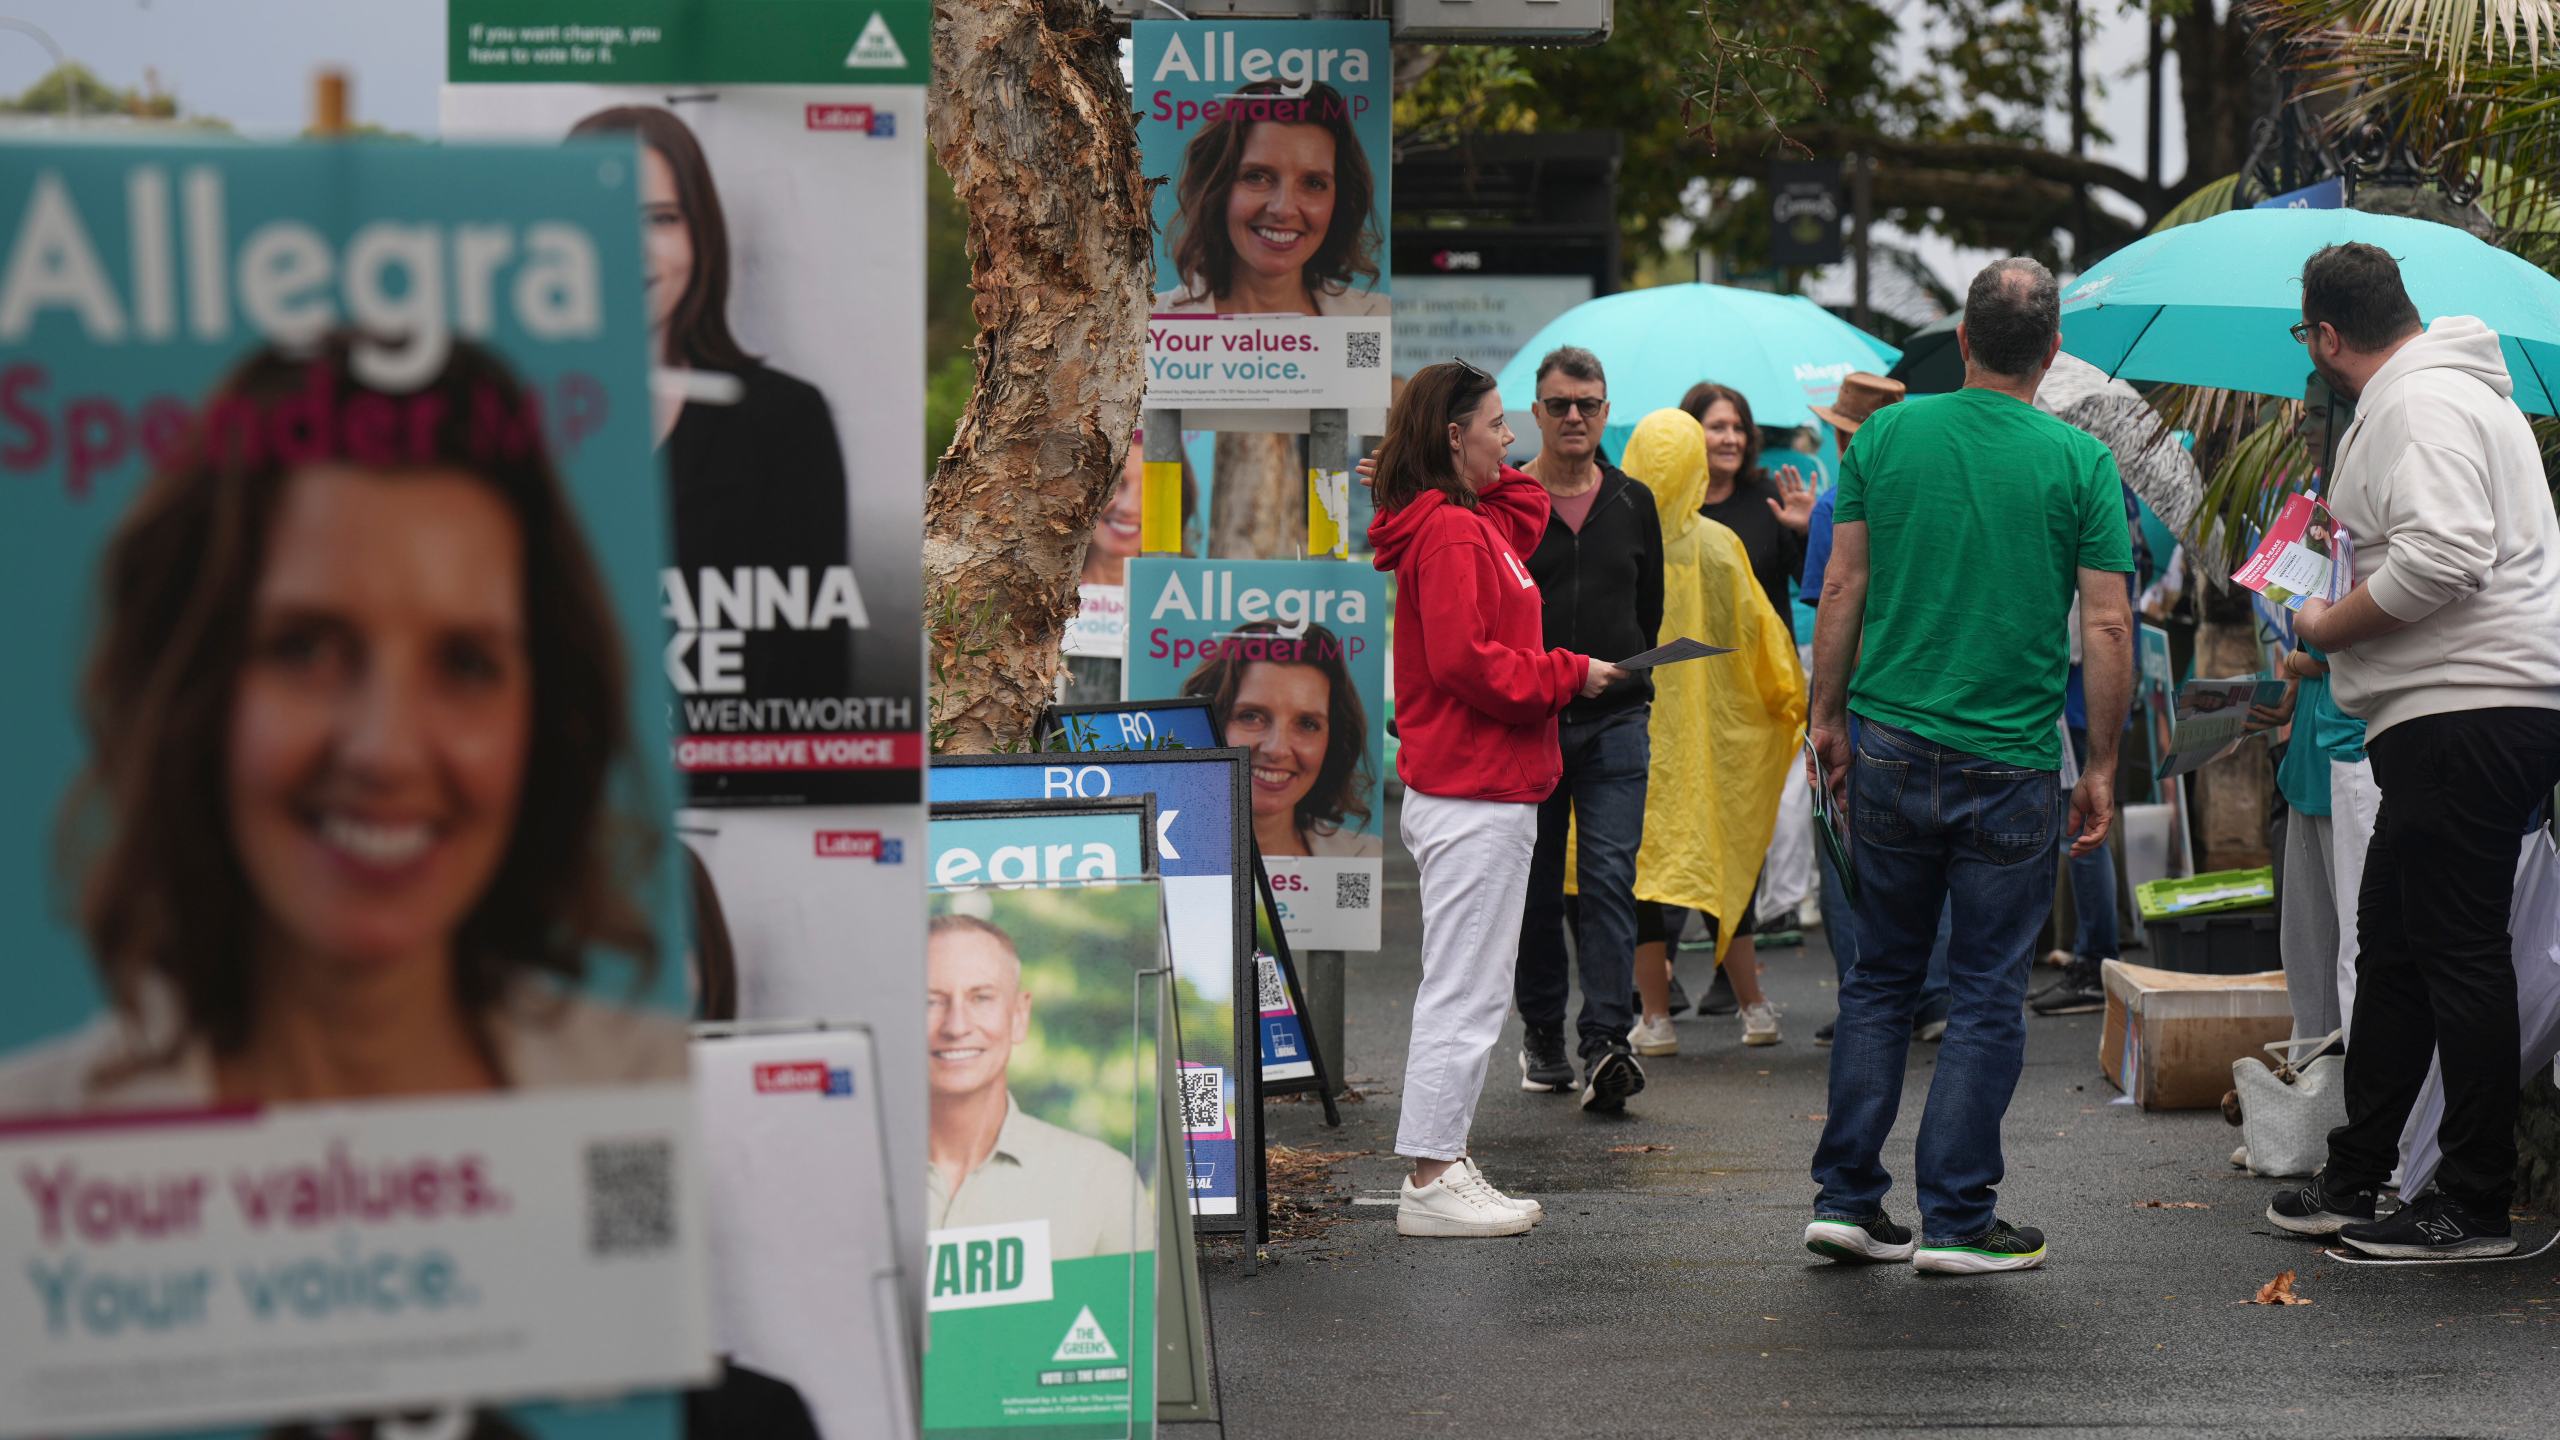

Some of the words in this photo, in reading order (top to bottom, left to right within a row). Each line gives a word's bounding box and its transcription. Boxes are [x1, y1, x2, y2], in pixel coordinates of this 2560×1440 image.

[486, 26, 516, 45] you
[519, 25, 560, 43] want
[562, 23, 627, 45] change,
[629, 26, 661, 45] you
[468, 46, 508, 64] have
[511, 48, 530, 64] to
[533, 47, 567, 64] vote
[570, 45, 594, 64] for
[1153, 31, 1370, 96] Allegra
[810, 108, 869, 128] Labor
[1152, 90, 1310, 130] Spender
[1322, 95, 1370, 121] MP
[0, 164, 605, 394] Allegra
[1148, 329, 1213, 352] Your
[1221, 328, 1319, 352] values.
[1149, 357, 1212, 380] Your
[1221, 356, 1306, 380] voice.
[0, 364, 441, 494] Spender
[659, 565, 870, 630] ANNA
[1150, 570, 1366, 639] Allegra
[662, 630, 746, 694] KE
[1149, 628, 1309, 668] Spender
[1319, 637, 1366, 662] MP
[684, 697, 912, 732] WENTWORTH
[1118, 712, 1155, 743] RO
[677, 739, 809, 767] GRESSIVE
[812, 737, 894, 765] VOICE
[819, 833, 875, 853] Labor
[935, 840, 1117, 891] egra
[1271, 874, 1309, 892] es.
[758, 1066, 822, 1090] Labor
[21, 1158, 209, 1243] Your
[230, 1137, 512, 1231] values.
[27, 1253, 212, 1338] Your
[236, 1229, 482, 1320] voice.
[928, 1236, 1024, 1298] ARD
[1062, 1342, 1106, 1355] GREENS
[1075, 1327, 1095, 1340] THE
